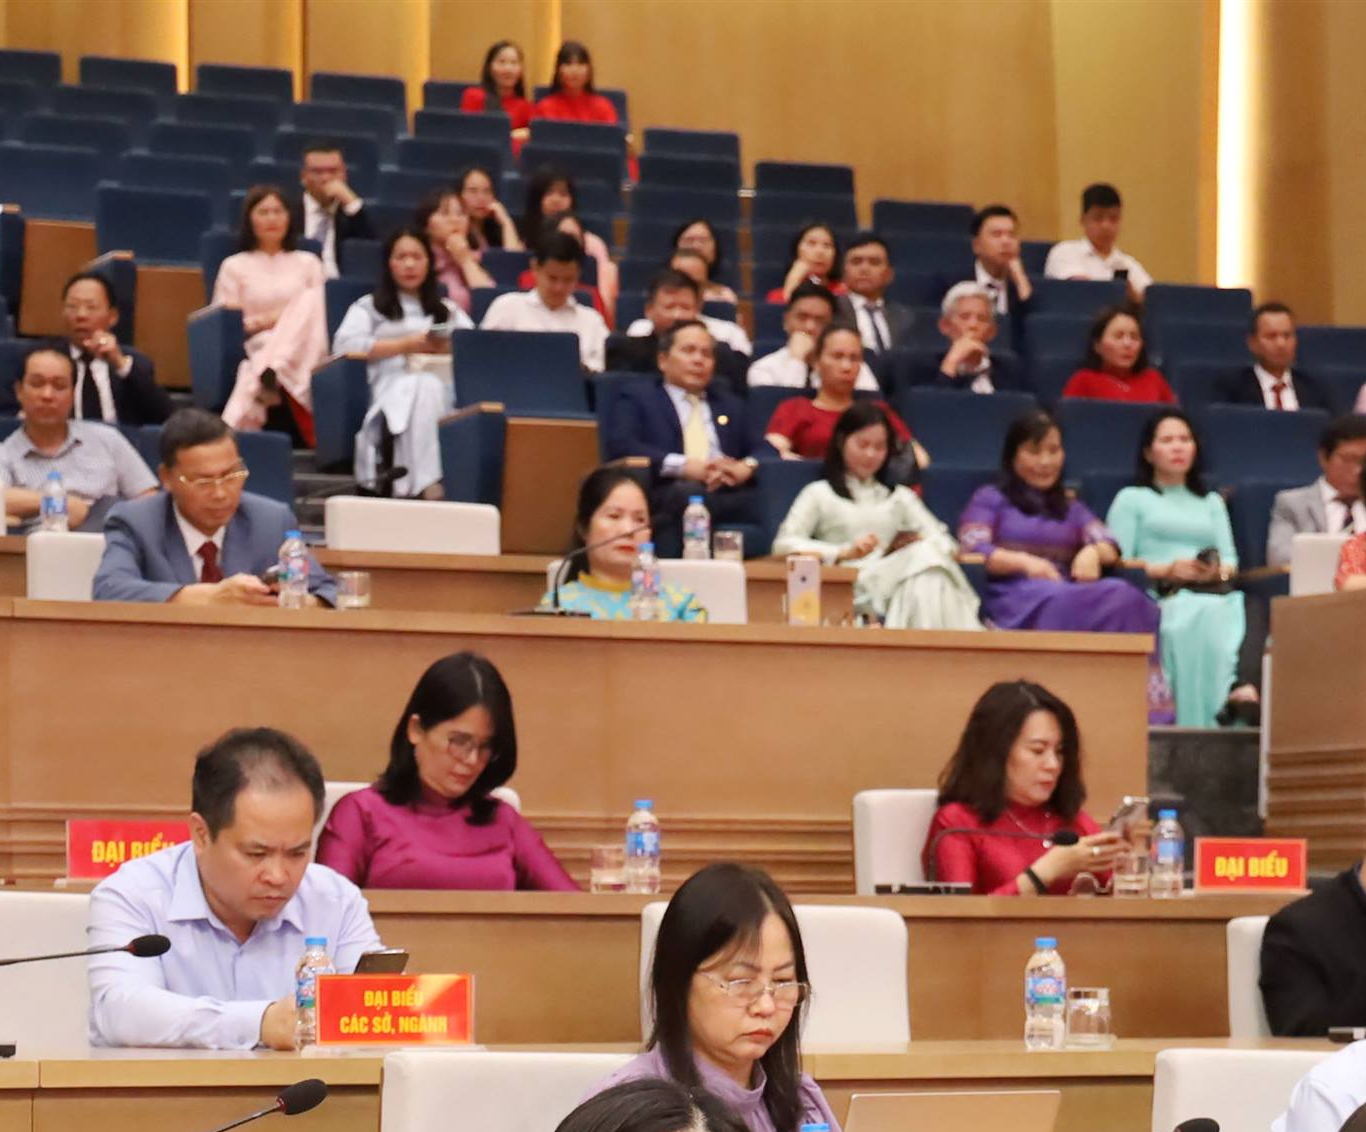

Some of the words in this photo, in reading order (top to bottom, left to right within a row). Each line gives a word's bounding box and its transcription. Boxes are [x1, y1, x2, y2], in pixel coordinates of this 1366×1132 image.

[91, 840, 125, 867] ĐẠI
[131, 832, 175, 859] BIỂ
[1215, 856, 1245, 881] ĐẠI
[364, 990, 388, 1010] ĐẠI
[340, 1013, 368, 1033] CÁC
[399, 1013, 447, 1033] NGÀNH
